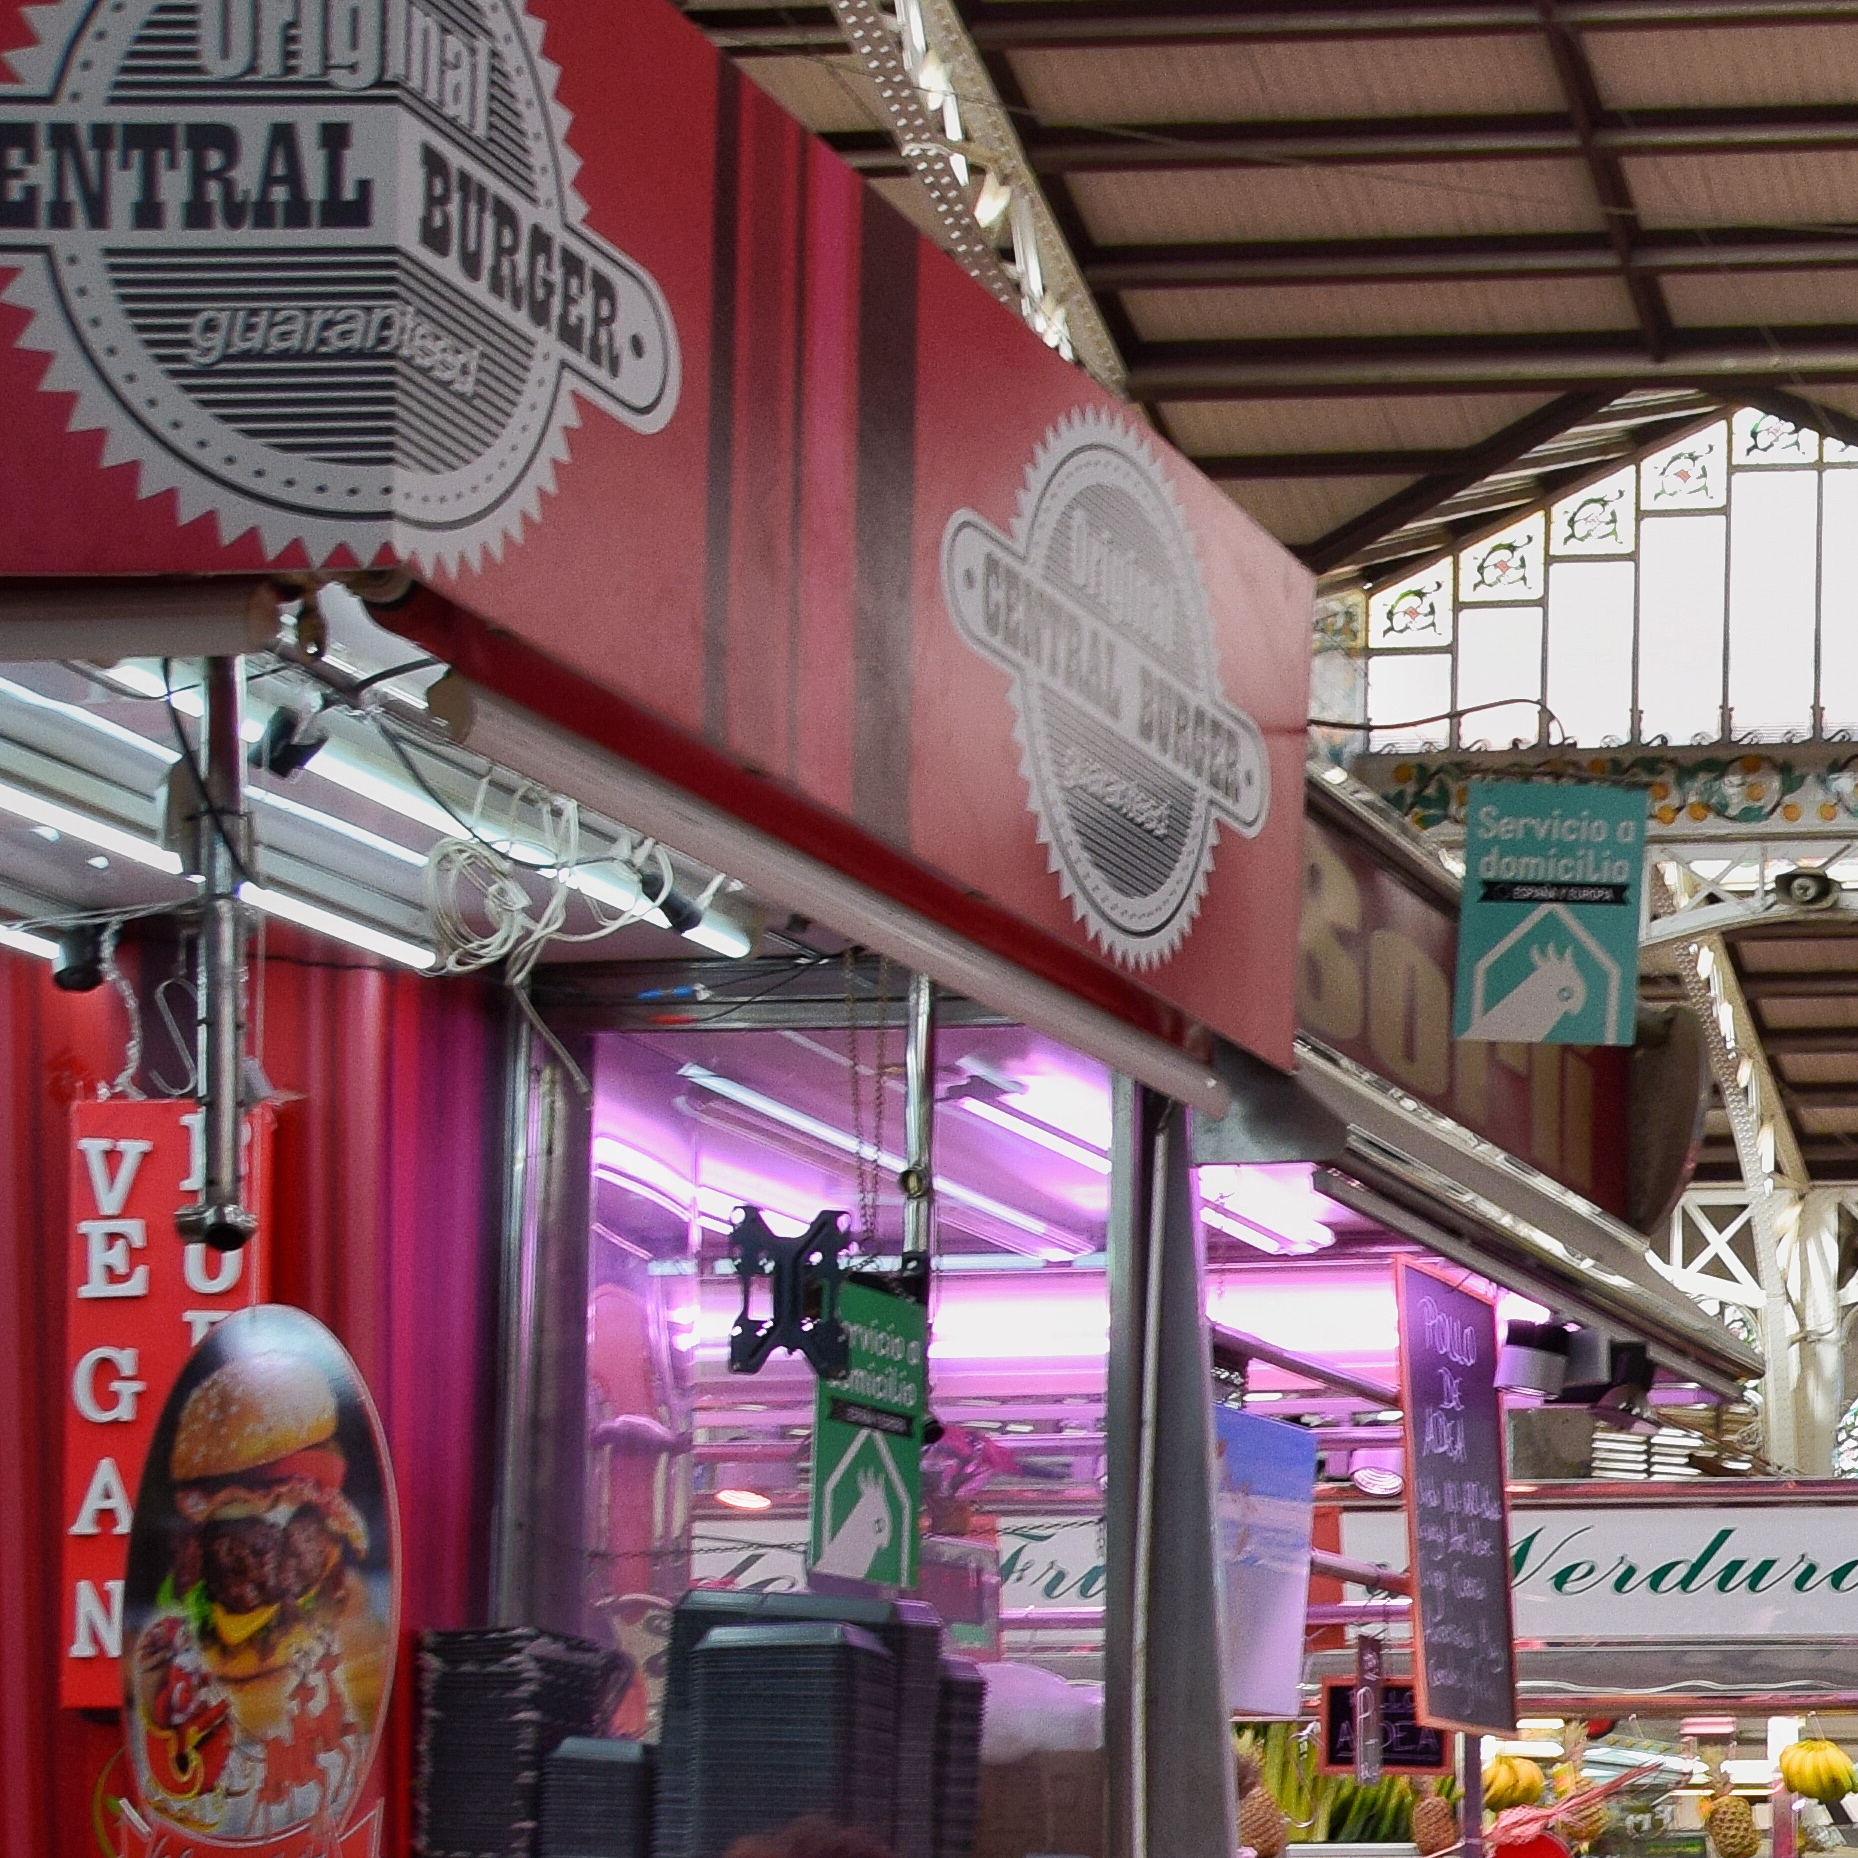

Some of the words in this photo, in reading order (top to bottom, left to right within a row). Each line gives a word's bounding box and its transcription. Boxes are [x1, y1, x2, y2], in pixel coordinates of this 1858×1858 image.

[418, 140, 624, 380] BURGER
[982, 551, 1123, 722] CENTRAL
[1136, 663, 1241, 804] BURGER
[1476, 804, 1610, 843] Servicio
[1615, 819, 1637, 844] a
[1478, 845, 1631, 882] domicilio
[1419, 1295, 1477, 1367] POLLO
[66, 1138, 153, 1659] VEGAN
[1437, 1366, 1465, 1411] DE
